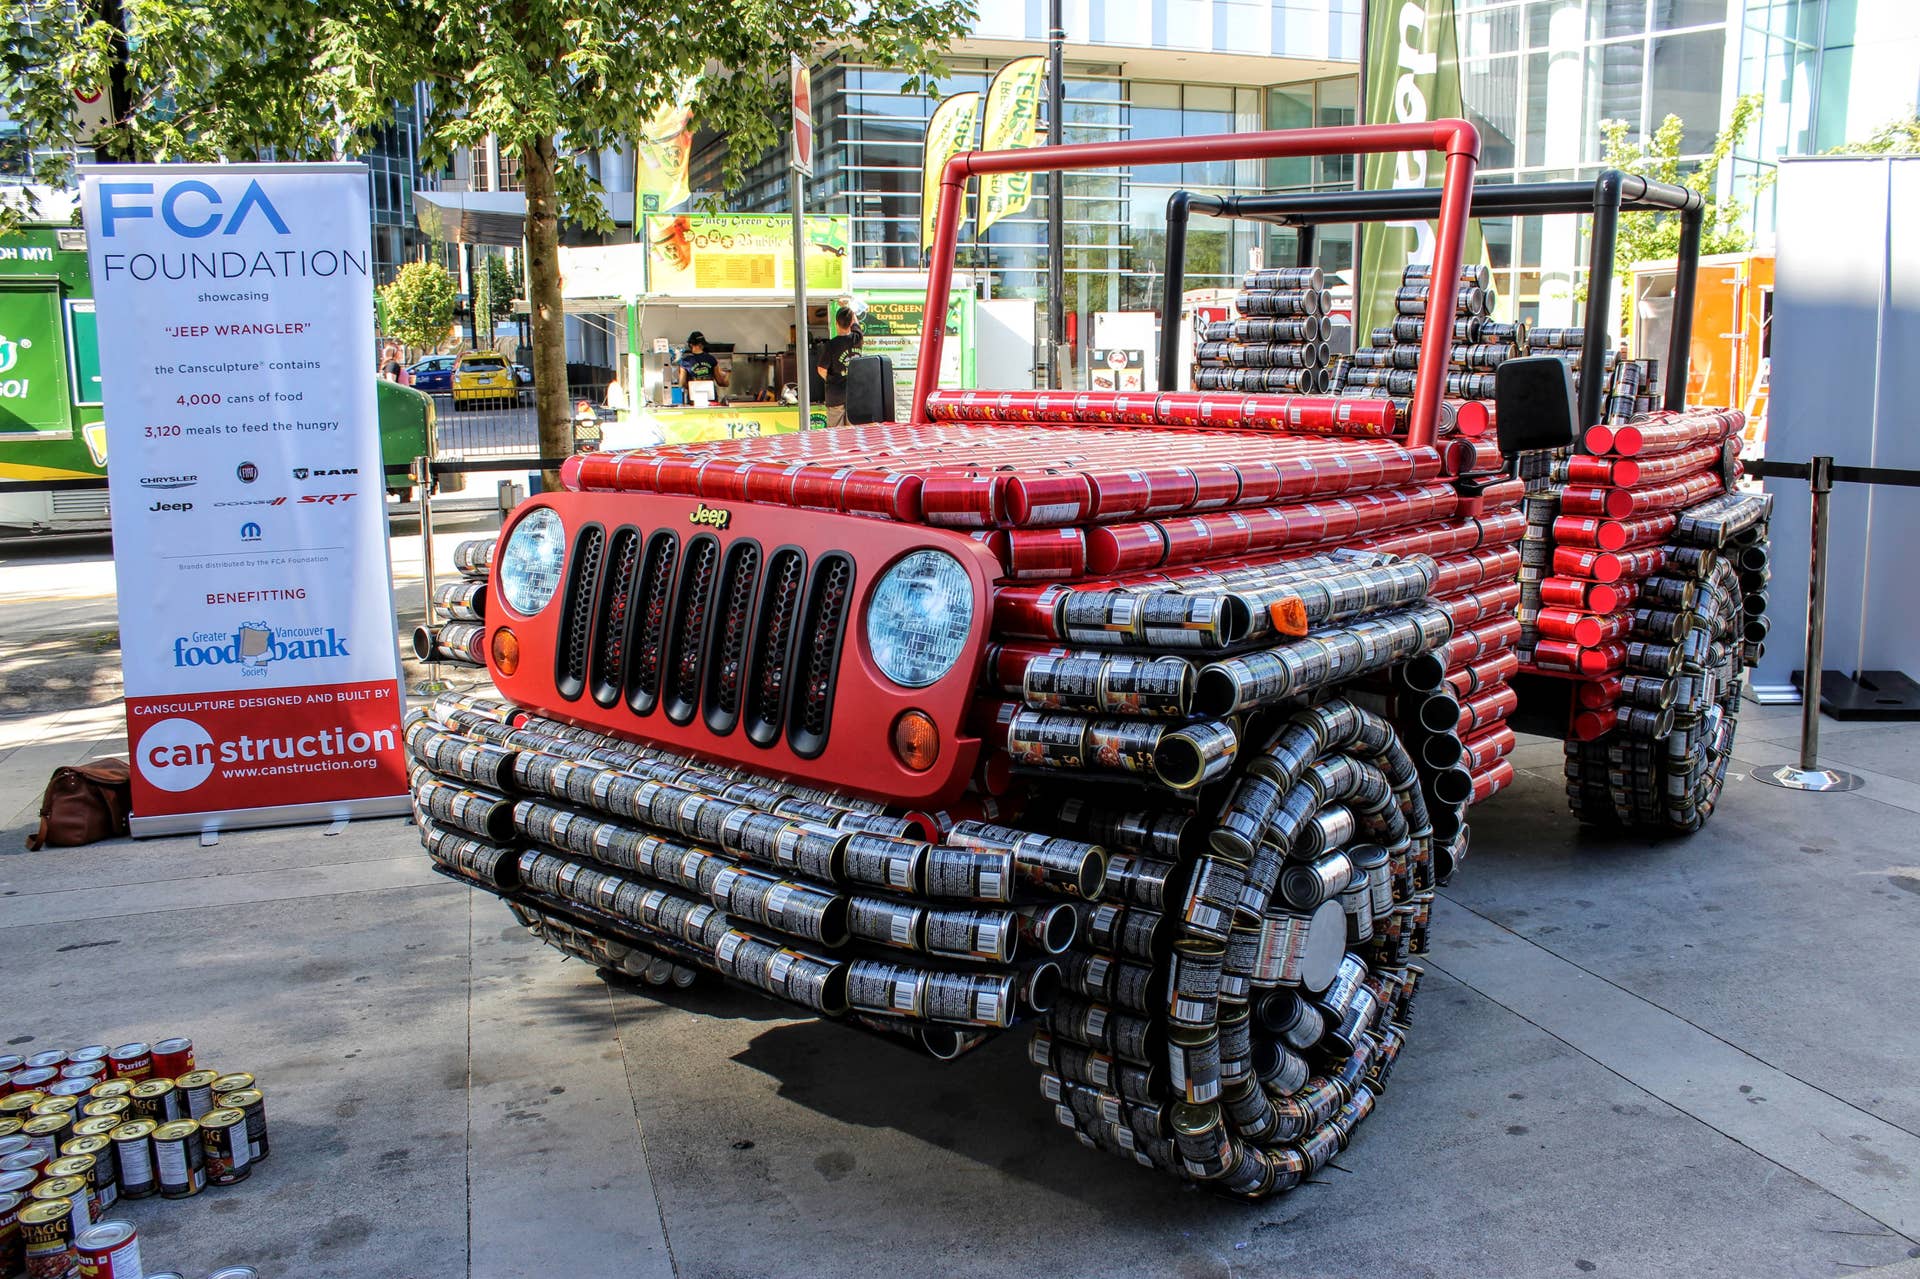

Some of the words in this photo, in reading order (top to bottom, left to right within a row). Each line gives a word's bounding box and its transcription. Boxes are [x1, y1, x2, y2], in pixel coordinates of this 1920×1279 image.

[99, 178, 292, 239] FCA
[732, 216, 762, 228] Green
[766, 216, 809, 229] Exprs
[22, 247, 53, 262] MY!
[104, 250, 367, 281] FOUNDATION
[198, 291, 269, 302] showcasing
[889, 303, 923, 313] GREEN
[165, 326, 209, 338] “JEEP
[214, 323, 311, 336] WRANGLER”
[155, 364, 174, 375] the
[269, 360, 321, 370] contains
[176, 393, 221, 407] 4,000
[227, 394, 255, 404] cans
[258, 392, 270, 402] of
[275, 391, 303, 401] food
[144, 425, 181, 439] 3,120
[186, 424, 222, 436] meals
[225, 423, 238, 434] to
[242, 422, 269, 433] feed
[272, 421, 293, 431] the
[296, 420, 339, 431] hungry
[140, 475, 198, 484] CHRYSLER
[313, 468, 358, 477] RAM
[296, 493, 358, 505] SRT
[149, 502, 193, 512] Jeep
[690, 503, 731, 529] Jeep
[206, 561, 244, 569] distributed
[246, 560, 255, 568] by
[288, 556, 329, 564] Foundation
[206, 588, 306, 605] BENEFITTING
[192, 631, 227, 643] Greater
[275, 626, 324, 638] Vancouver
[173, 634, 242, 668] food
[268, 628, 351, 661] bank
[241, 667, 268, 678] Society
[134, 699, 235, 716] CANSCULPTURE
[240, 695, 302, 709] DESIGNED
[306, 693, 333, 704] AND
[337, 690, 371, 702] BUILT
[375, 688, 391, 699] BY
[222, 758, 378, 779] www.canstruction.org
[20, 1218, 69, 1239] STAGG
